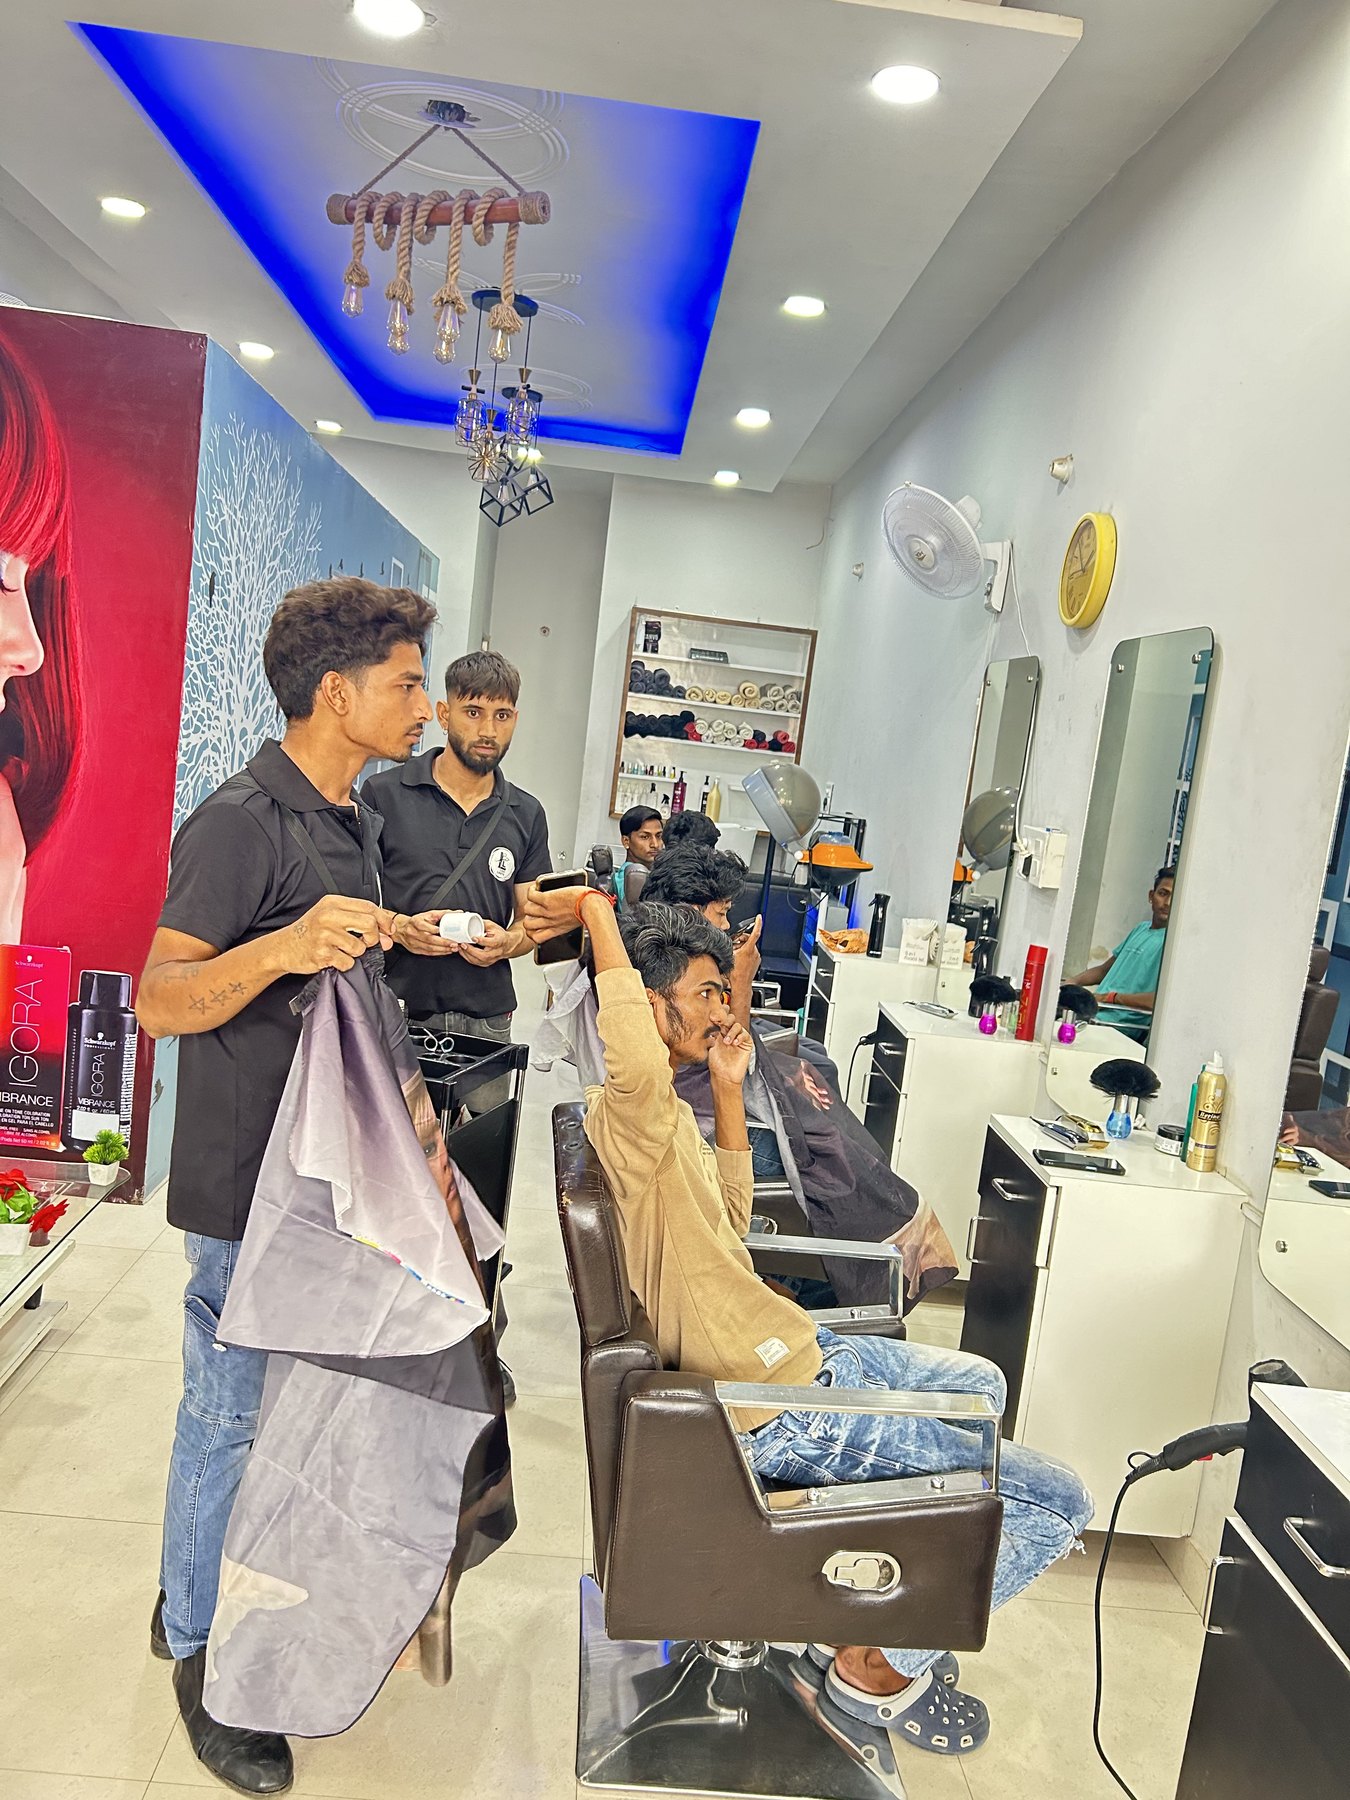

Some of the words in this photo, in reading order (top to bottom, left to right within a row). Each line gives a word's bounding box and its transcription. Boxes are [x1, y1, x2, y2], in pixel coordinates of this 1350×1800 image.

[8, 979, 43, 1088] IGORA
[84, 1037, 117, 1047] Schwarzkopf
[91, 1053, 106, 1098] IGORA
[78, 1097, 116, 1109] VIBRANCE
